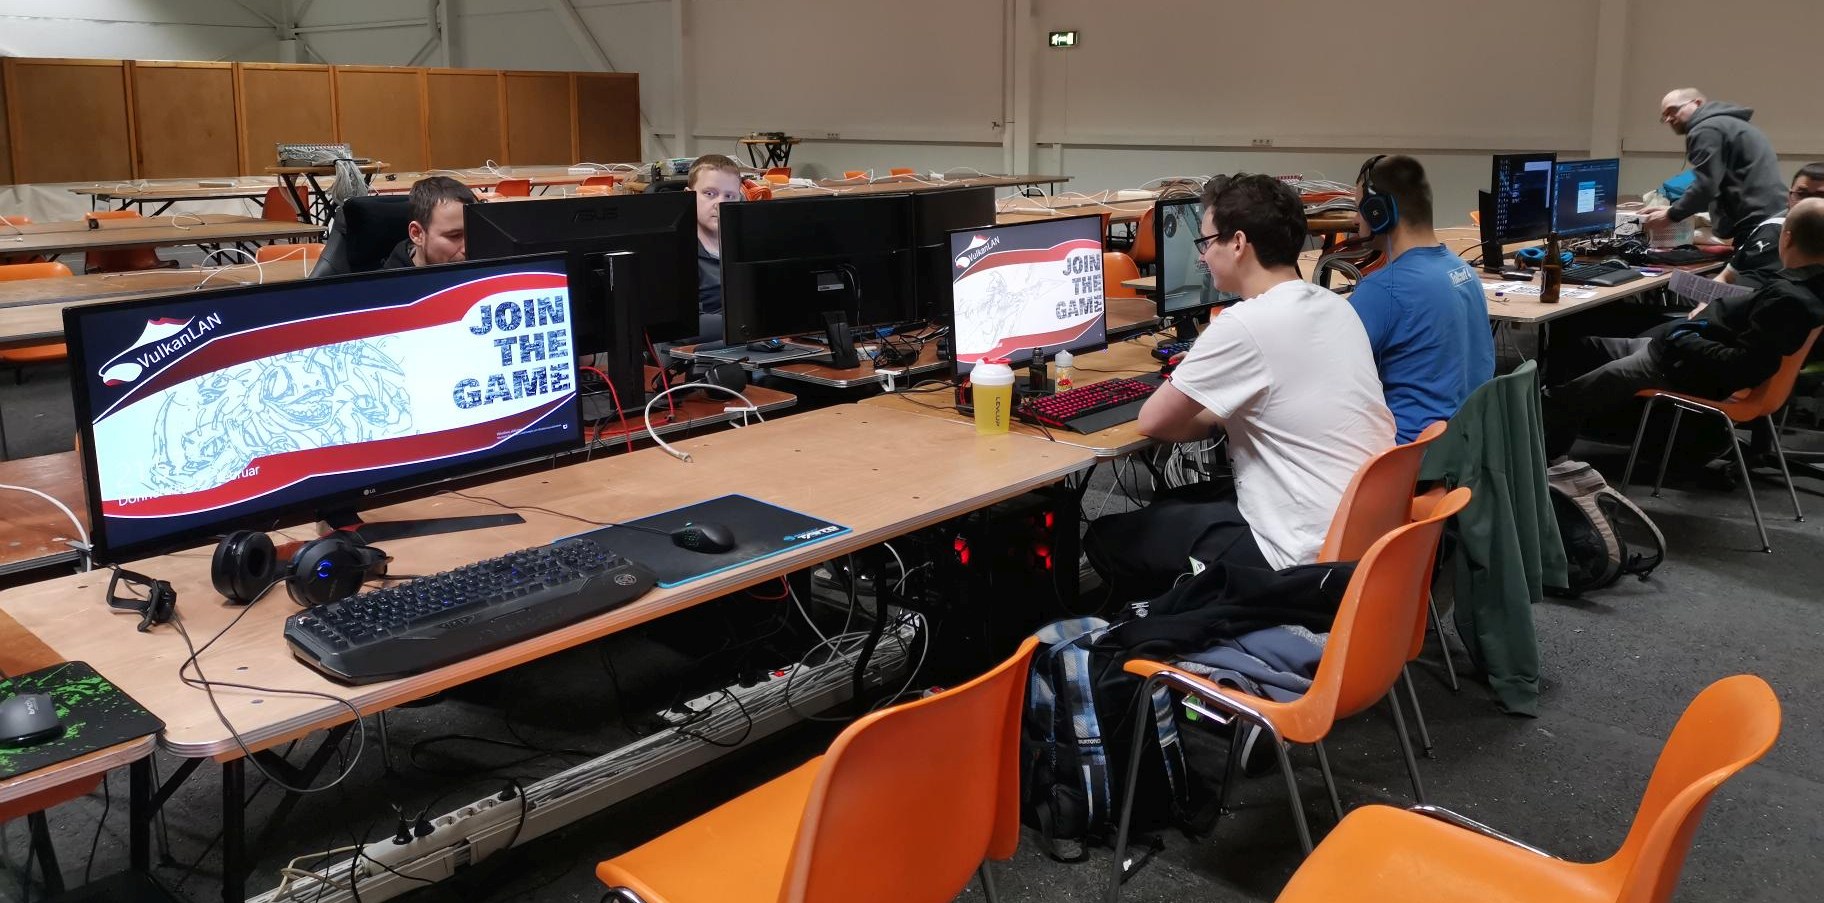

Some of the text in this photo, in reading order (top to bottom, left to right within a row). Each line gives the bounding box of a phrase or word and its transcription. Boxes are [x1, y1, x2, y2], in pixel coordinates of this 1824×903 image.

[968, 235, 1001, 262] VulkanLAN
[1062, 253, 1101, 276] JOIN
[1071, 274, 1102, 296] THE
[469, 295, 565, 336] JOIN
[1055, 294, 1103, 320] GAME
[136, 312, 222, 368] VulkanLAN
[493, 329, 569, 367] THE
[452, 362, 571, 410] GAME
